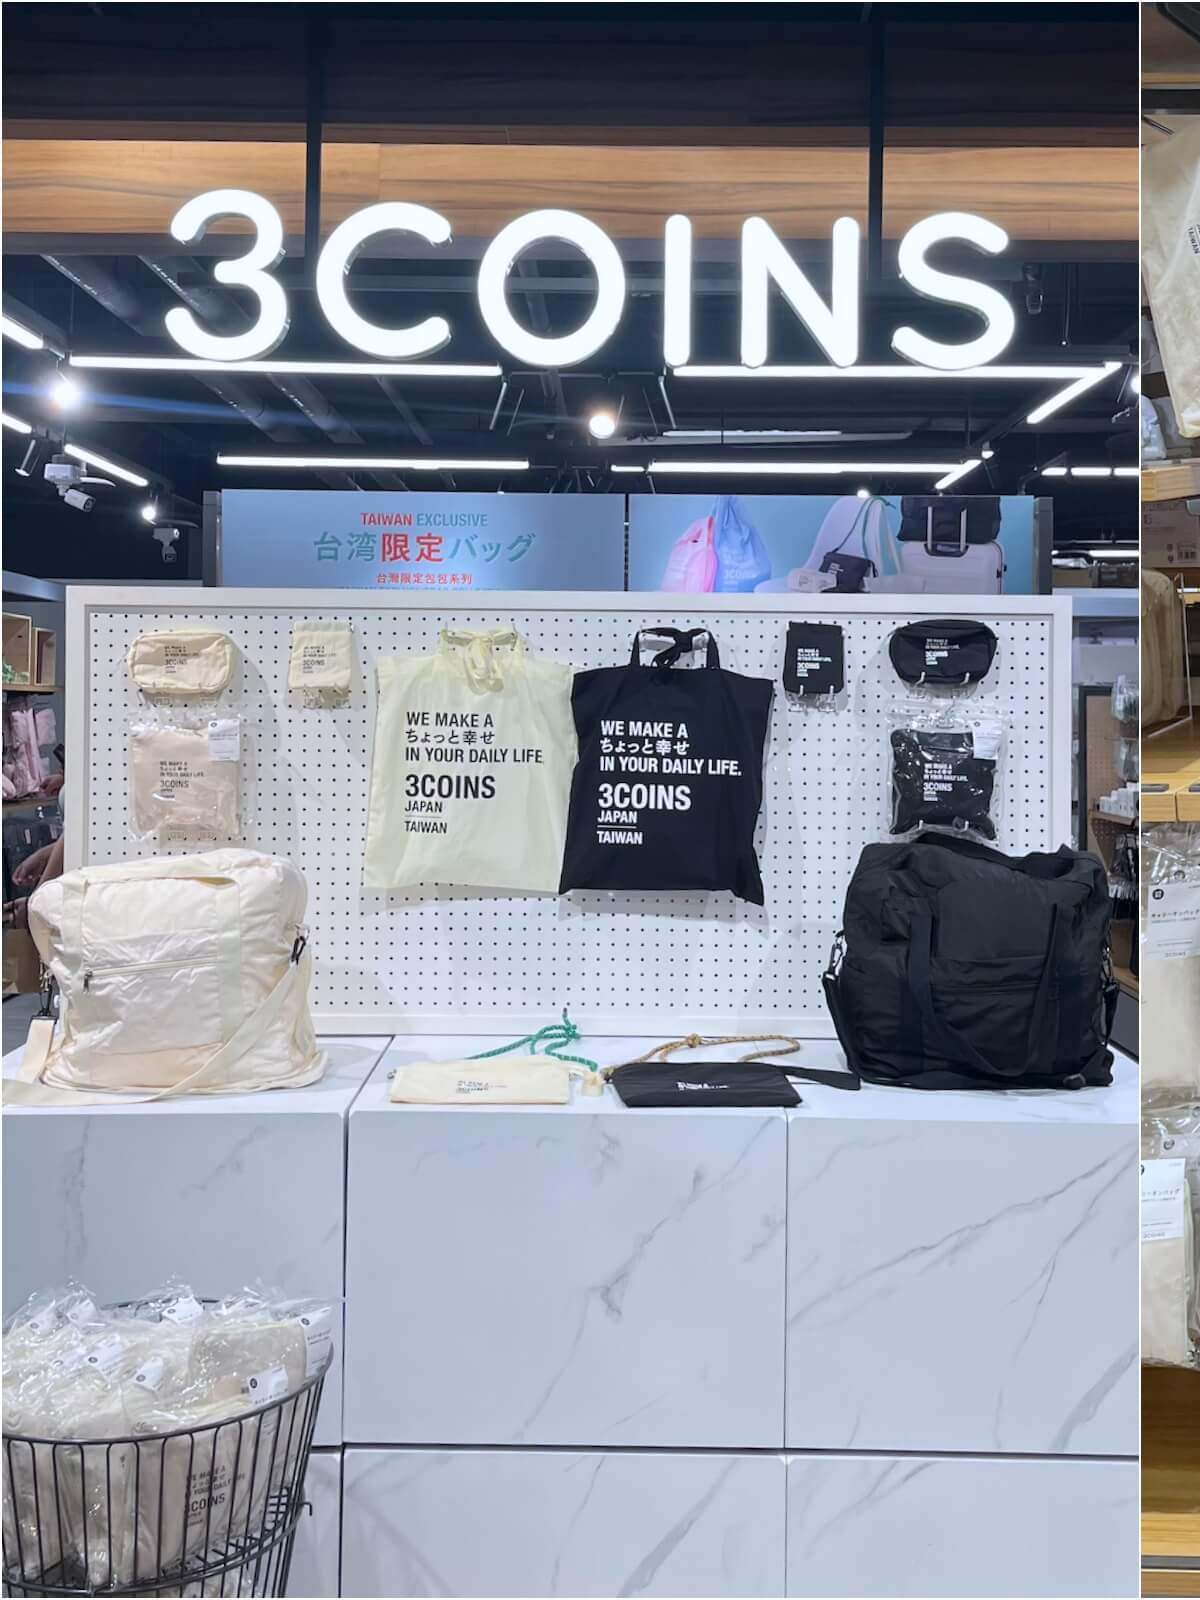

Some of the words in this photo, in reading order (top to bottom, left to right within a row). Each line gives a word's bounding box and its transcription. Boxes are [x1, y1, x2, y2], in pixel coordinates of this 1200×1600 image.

[164, 188, 1016, 371] 3COINS
[360, 512, 412, 526] TAIWAN
[416, 513, 489, 527] EXCLUSIVE
[313, 531, 536, 562] 台湾限定バッグ
[407, 711, 429, 726] WE
[435, 712, 480, 727] MAKE
[483, 714, 494, 728] A
[405, 728, 495, 745] ちょっと幸せ
[600, 720, 624, 736] WE
[629, 721, 673, 738] MAKE
[677, 723, 688, 738] A
[405, 747, 420, 761] IN
[425, 748, 464, 763] YOUR
[469, 749, 508, 763] DAILY
[600, 737, 690, 756] ちょっと幸せ
[600, 756, 615, 771] IN
[619, 757, 658, 773] YOUR
[662, 758, 704, 774] DAILY
[708, 759, 742, 776] LIFE.
[405, 774, 496, 799] 3COINS
[598, 783, 692, 811] 3COINS
[405, 800, 443, 813] JAPAN
[597, 810, 638, 823] JAPAN
[405, 821, 448, 834] TAIWAN
[597, 831, 643, 845] TAIWAN
